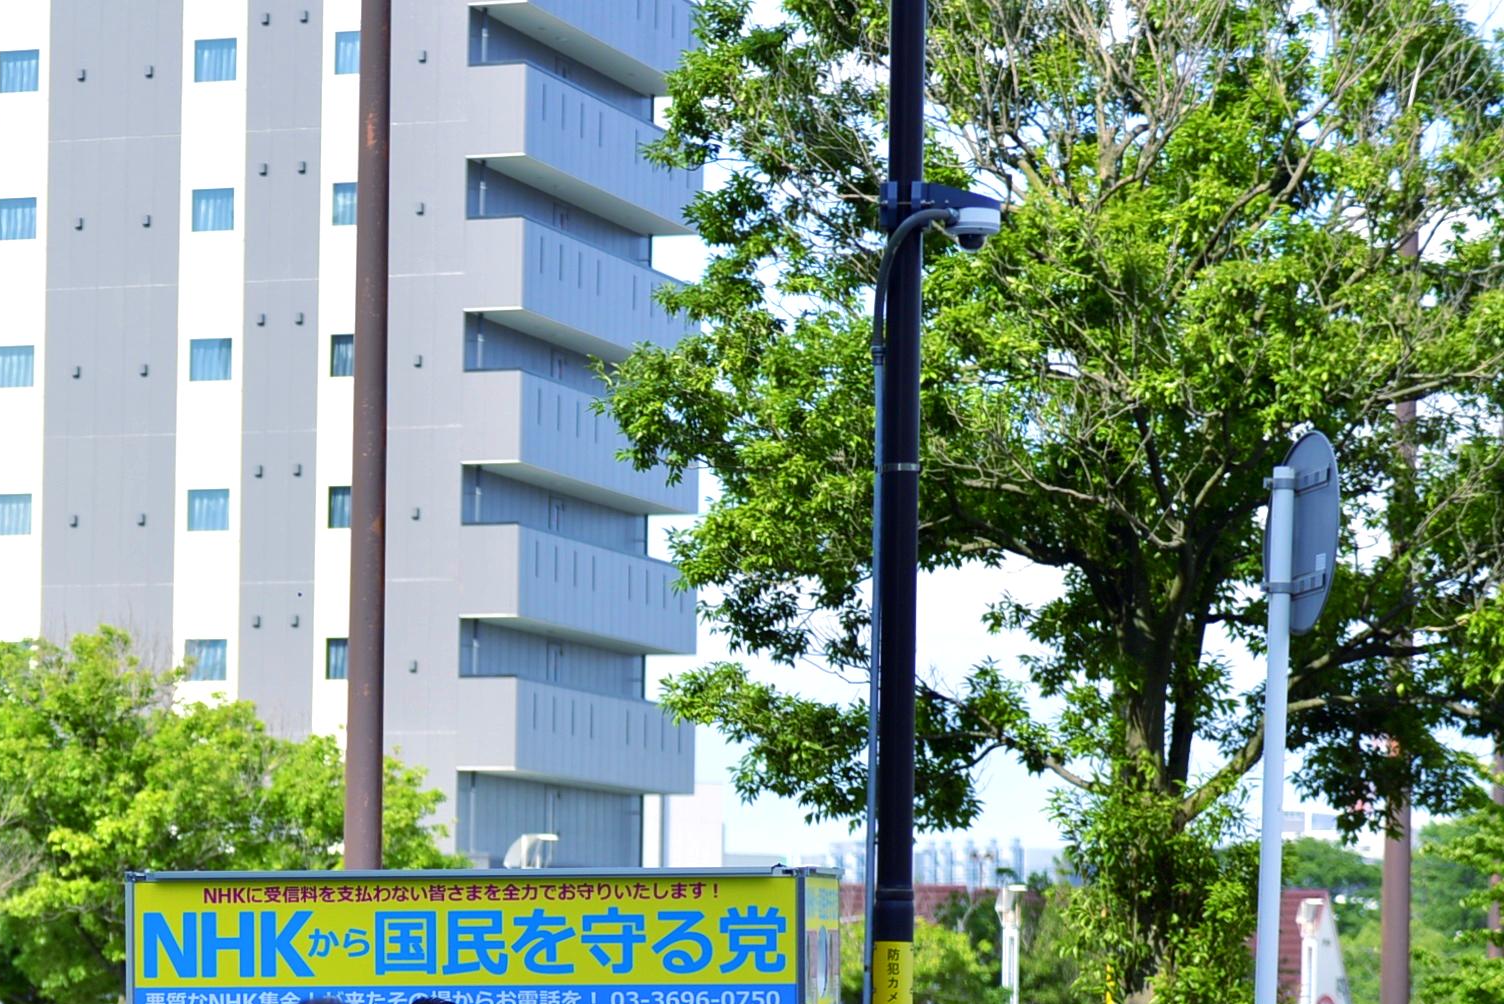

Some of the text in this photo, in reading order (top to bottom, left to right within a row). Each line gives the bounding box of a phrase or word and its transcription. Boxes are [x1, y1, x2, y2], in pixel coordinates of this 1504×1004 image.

[203, 883, 719, 904] NHKに受信料を支払わない皆さまを全力でお守りいたします！
[143, 906, 786, 979] NHKから国民を守る党
